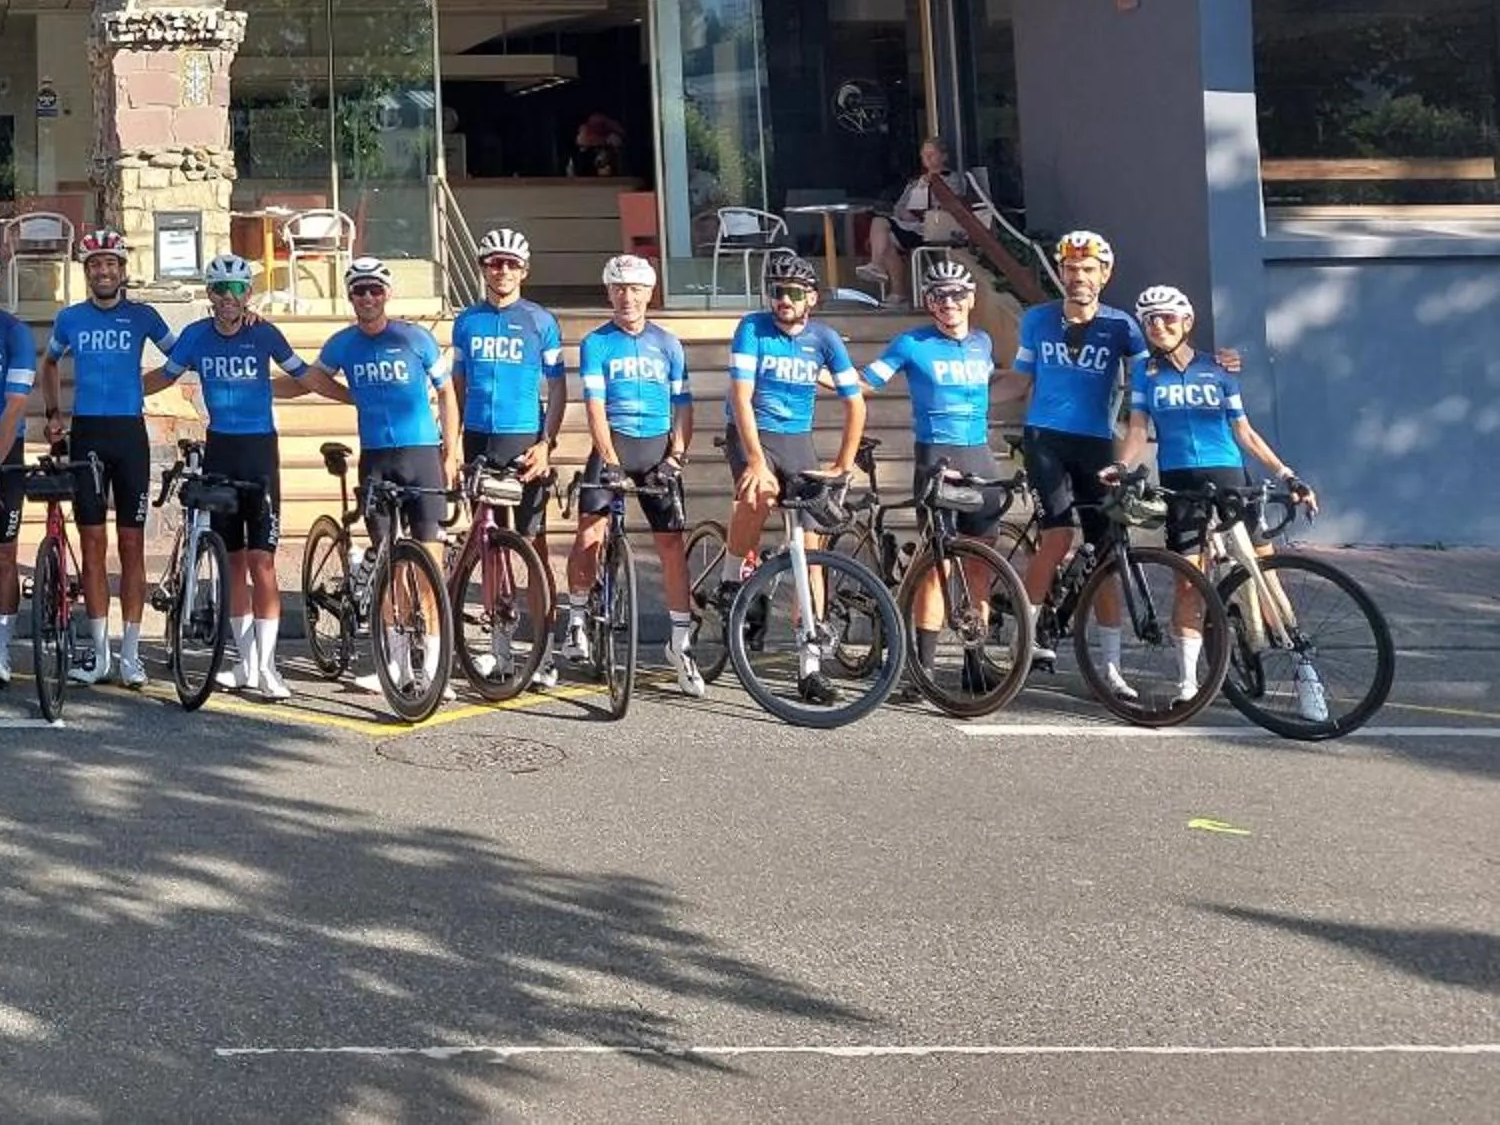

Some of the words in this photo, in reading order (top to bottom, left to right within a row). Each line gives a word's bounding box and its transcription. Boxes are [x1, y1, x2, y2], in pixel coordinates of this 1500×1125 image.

[78, 329, 131, 351] PRCC
[471, 336, 523, 359] PRCC
[201, 356, 258, 377] PRCC
[353, 360, 409, 383] PRCC
[761, 356, 819, 382] PRCC
[1153, 384, 1220, 408] PRCC
